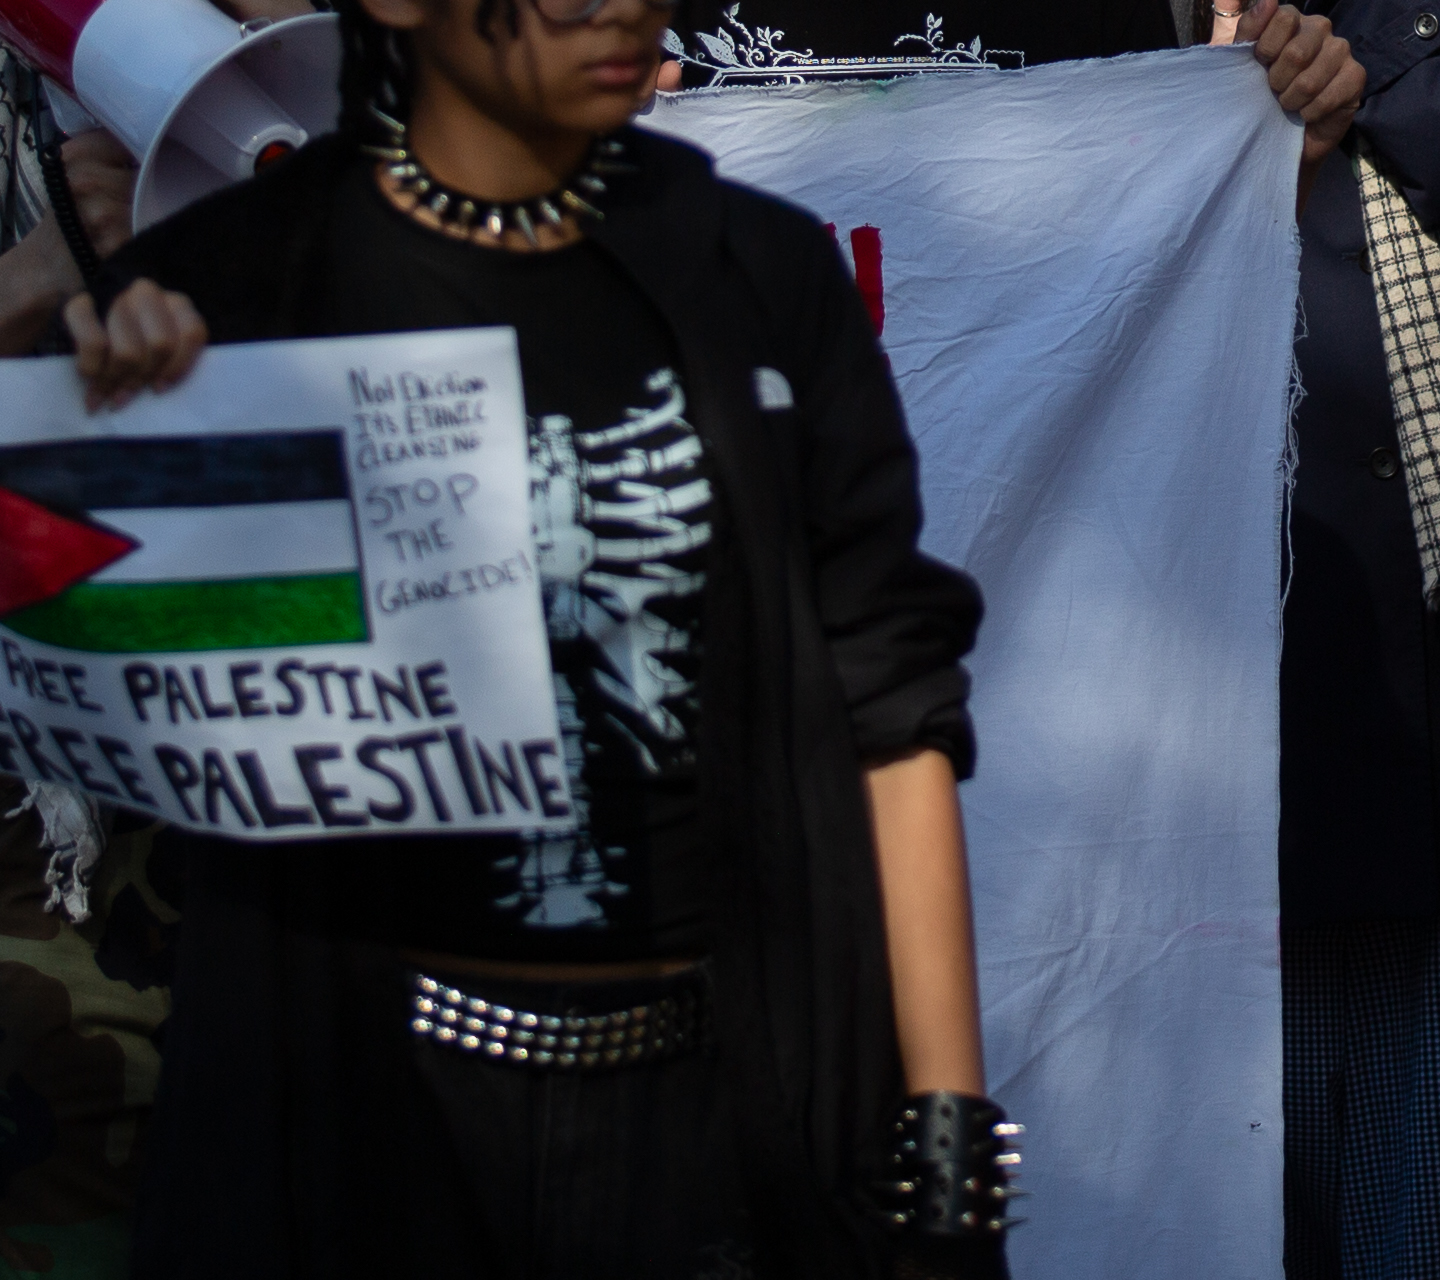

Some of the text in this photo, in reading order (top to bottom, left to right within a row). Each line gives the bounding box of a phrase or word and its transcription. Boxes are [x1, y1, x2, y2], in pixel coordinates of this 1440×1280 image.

[836, 56, 866, 65] capable
[366, 472, 480, 528] STOP
[385, 518, 455, 563] THE
[375, 550, 533, 615] GENOCIDE!
[0, 636, 458, 724] FREE PALESTINE
[154, 724, 572, 830] PALESTINE
